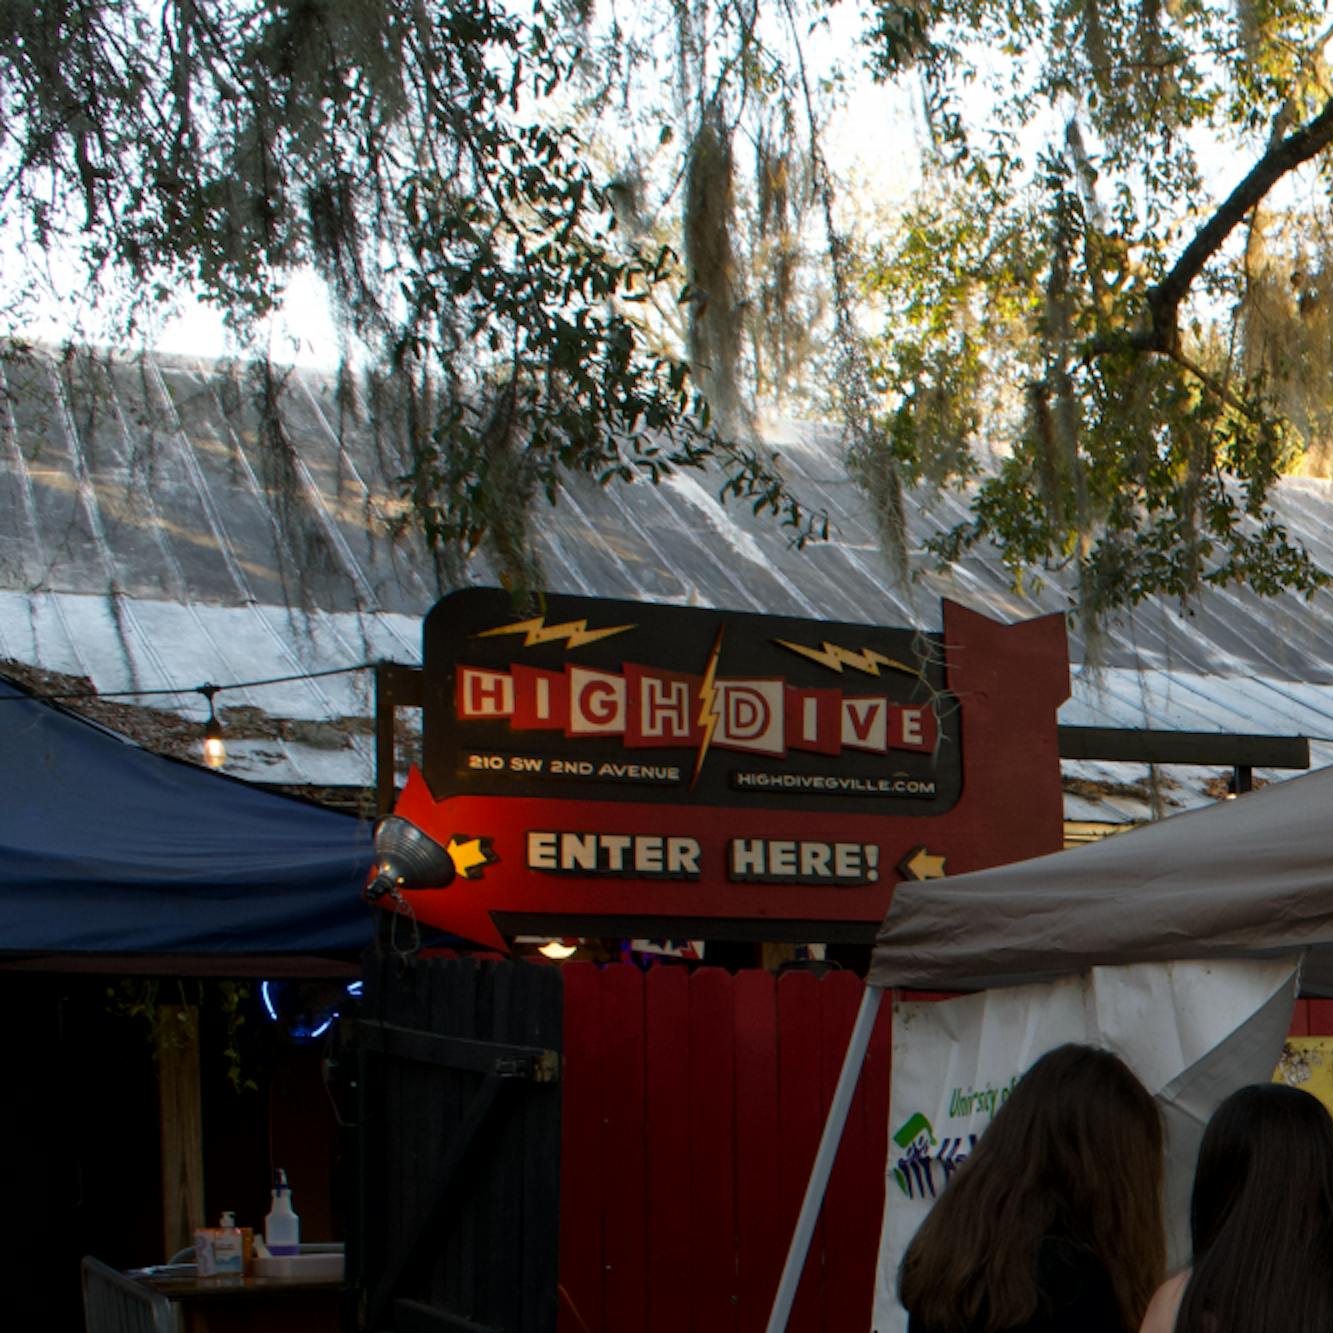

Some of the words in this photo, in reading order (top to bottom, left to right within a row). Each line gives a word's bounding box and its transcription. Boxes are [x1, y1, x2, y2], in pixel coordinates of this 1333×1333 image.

[468, 672, 691, 738] HIGH
[723, 685, 925, 746] DIVE
[468, 754, 505, 771] 210
[510, 756, 543, 772] SW
[550, 760, 594, 776] 2ND
[599, 762, 681, 780] AVENUE
[737, 771, 937, 794] HIGHDIVEGVILLE.COM
[527, 831, 701, 874] ENTER
[732, 838, 880, 882] HERE!
